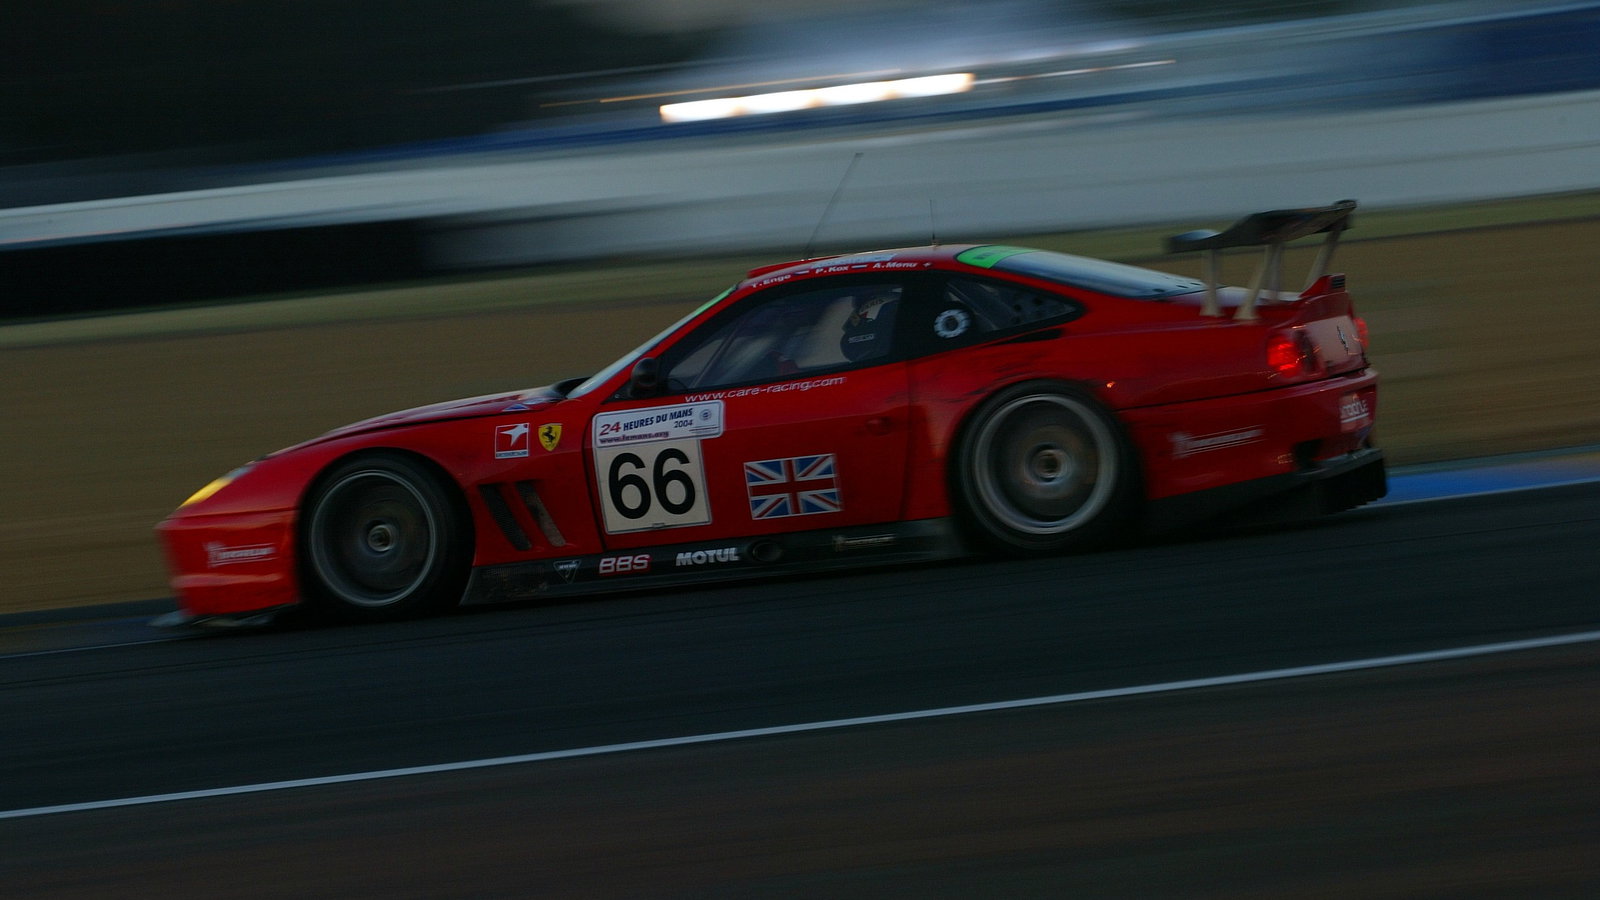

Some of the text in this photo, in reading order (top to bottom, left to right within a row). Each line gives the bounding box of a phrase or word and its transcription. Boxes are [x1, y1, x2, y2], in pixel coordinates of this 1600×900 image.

[685, 376, 847, 403] www.care-racing.com
[599, 408, 693, 436] 24 HEURES DU MANS
[673, 419, 693, 428] 2004
[608, 448, 696, 519] 66
[599, 554, 652, 574] BBS
[675, 547, 741, 566] MOTUL
